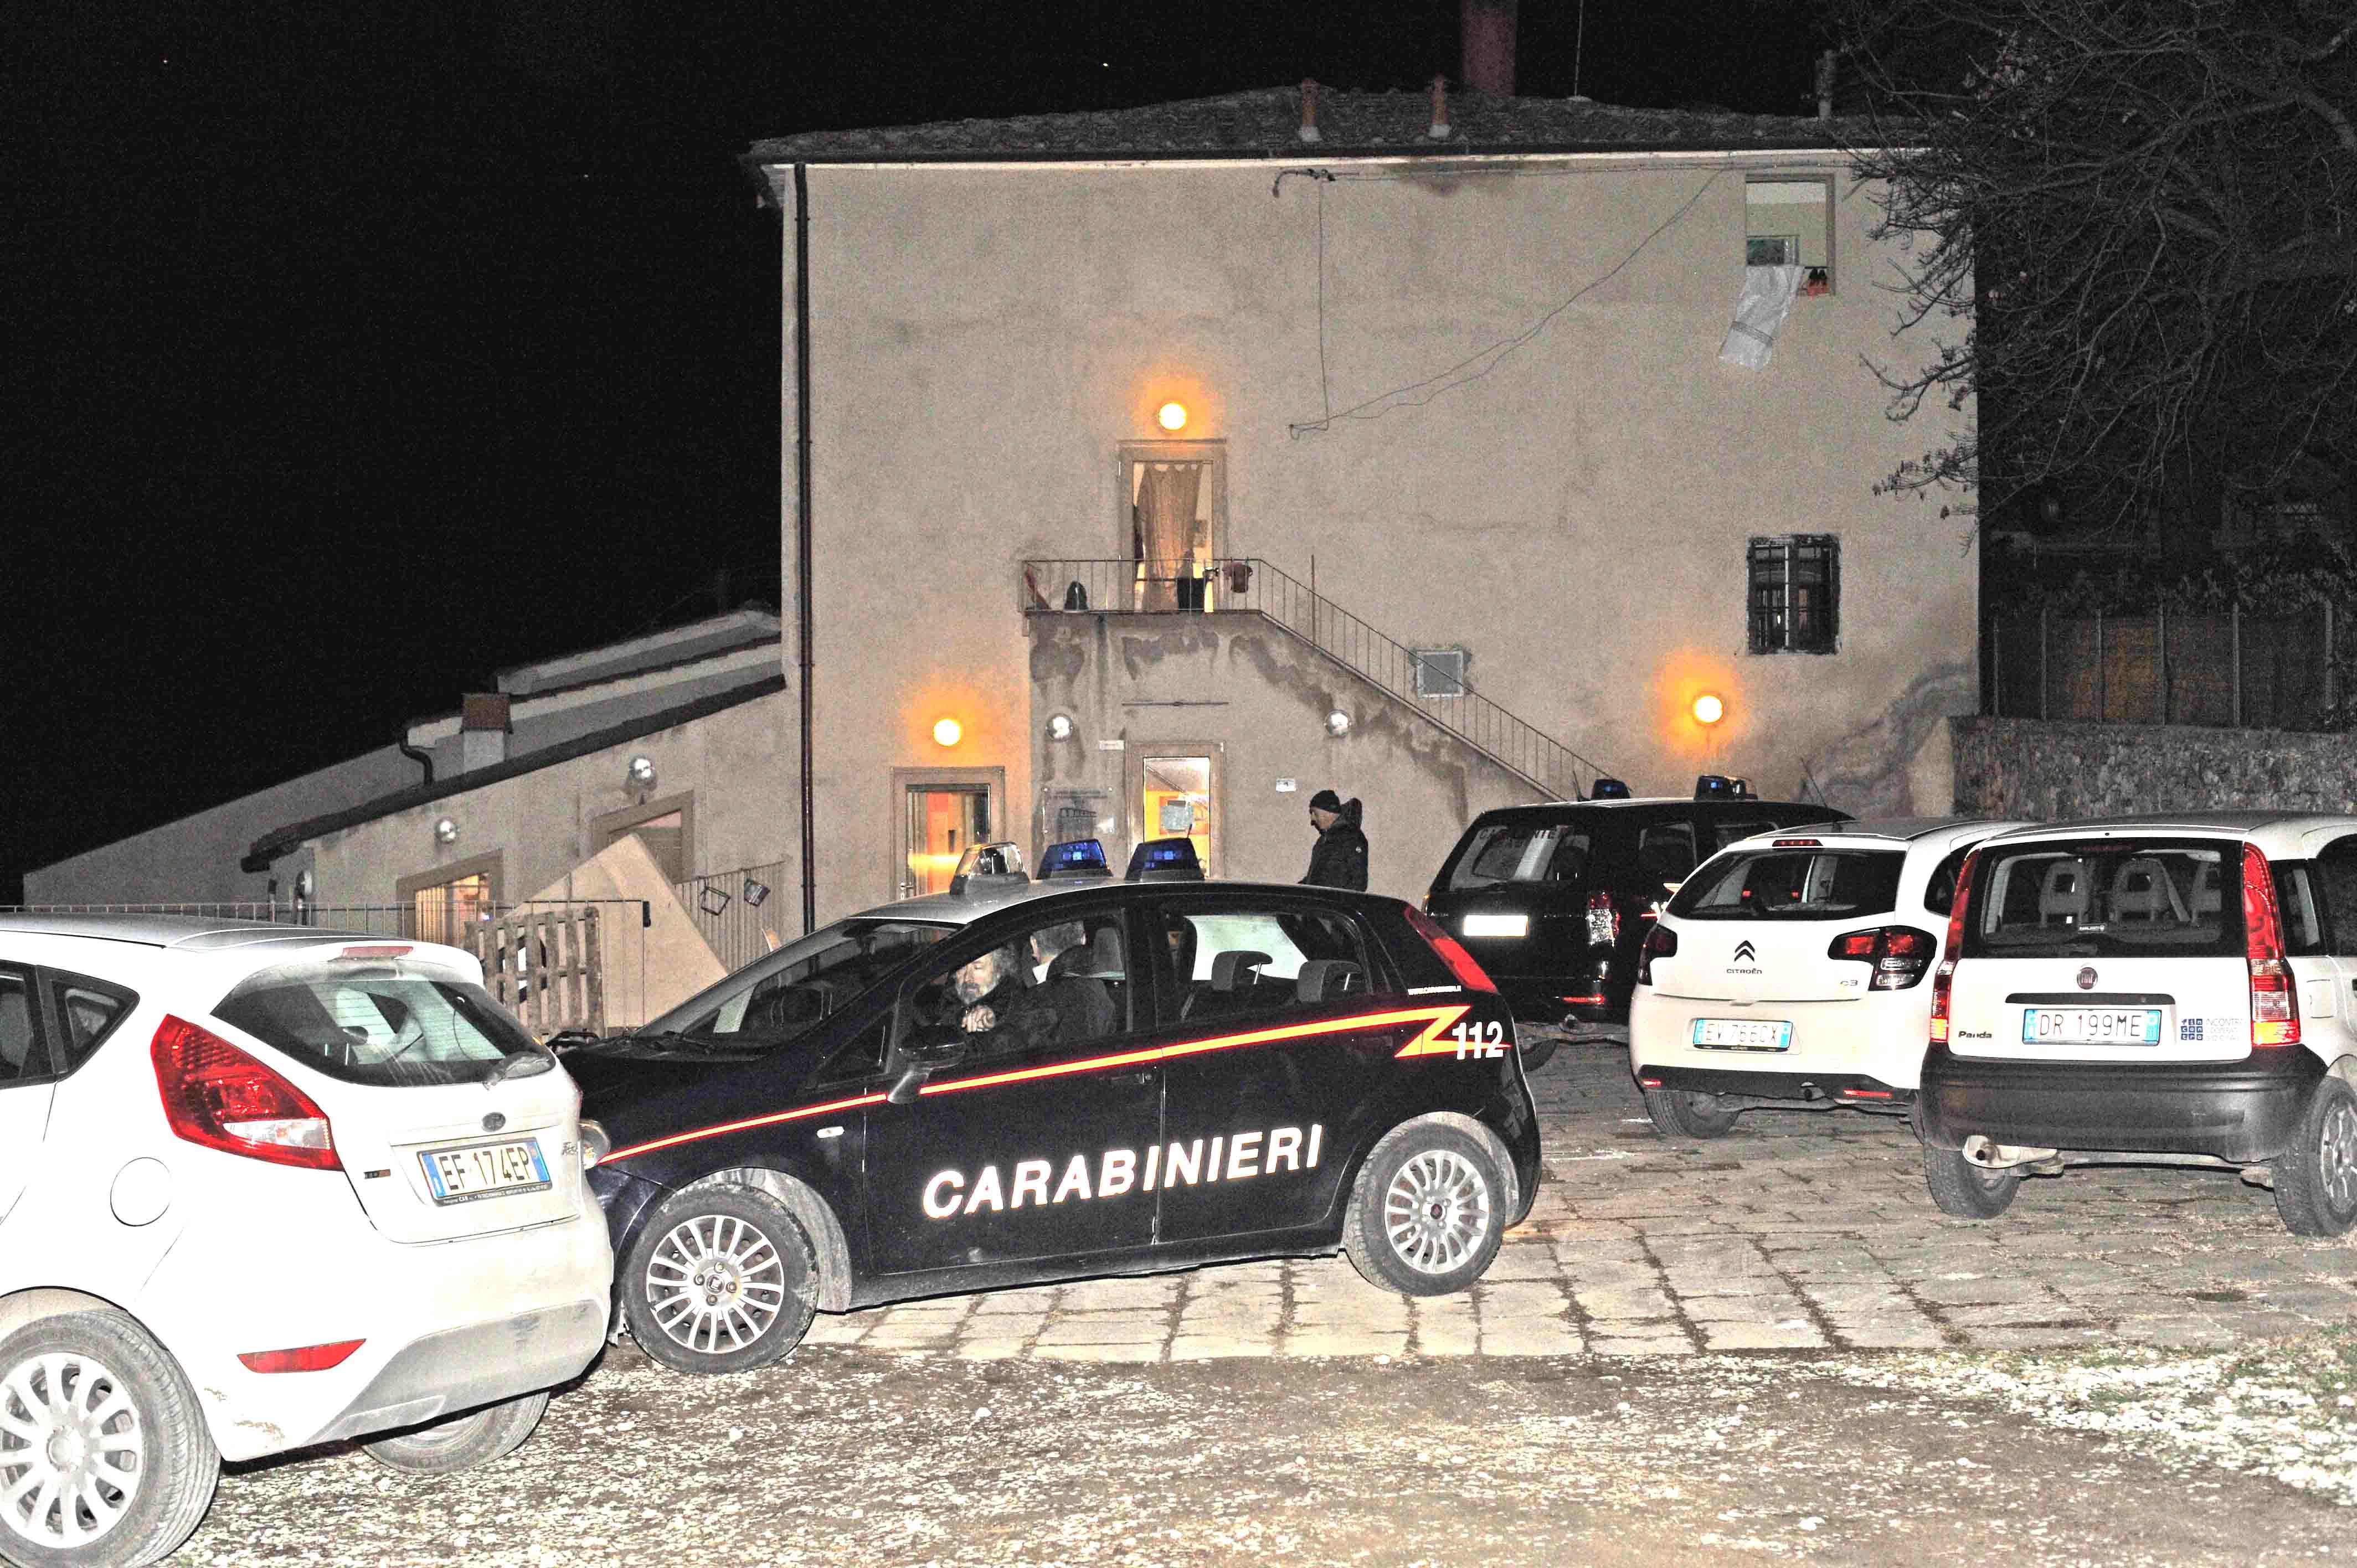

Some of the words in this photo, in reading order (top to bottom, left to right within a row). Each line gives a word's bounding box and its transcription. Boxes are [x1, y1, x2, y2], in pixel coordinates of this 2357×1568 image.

[1452, 1020, 1504, 1060] 112
[1958, 1030, 1992, 1039] Panda
[2040, 1014, 2064, 1036] DR
[2078, 1014, 2142, 1037] 199ME
[438, 1153, 465, 1191] EF
[474, 1146, 534, 1185] 174EP
[922, 1123, 1324, 1219] CARABINIERI
